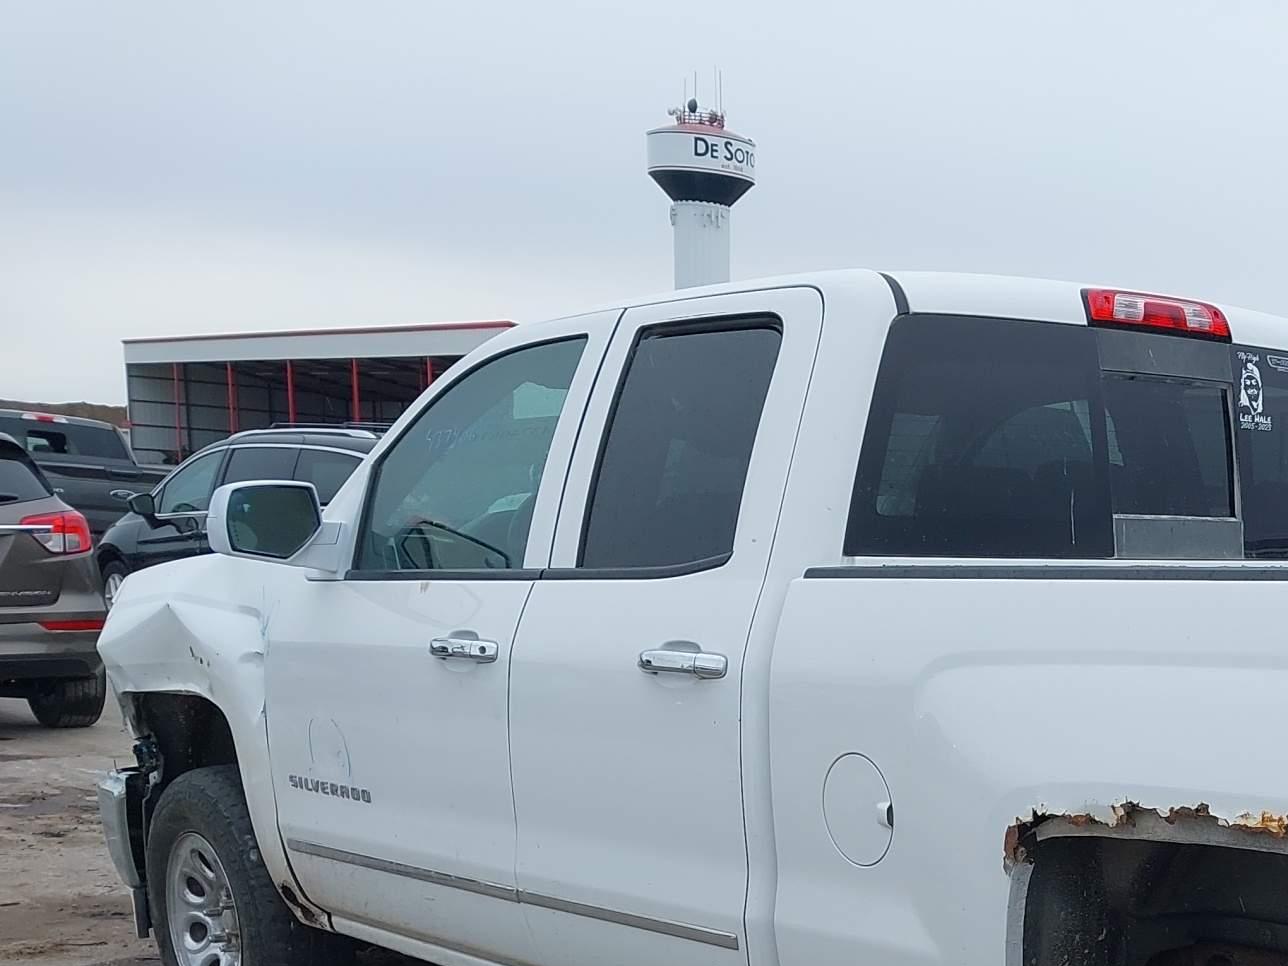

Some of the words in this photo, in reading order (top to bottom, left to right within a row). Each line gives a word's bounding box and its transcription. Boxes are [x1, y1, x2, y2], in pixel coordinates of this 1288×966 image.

[1239, 412, 1253, 422] LEE
[1254, 414, 1272, 424] HALE
[288, 774, 372, 804] SILVERADO
